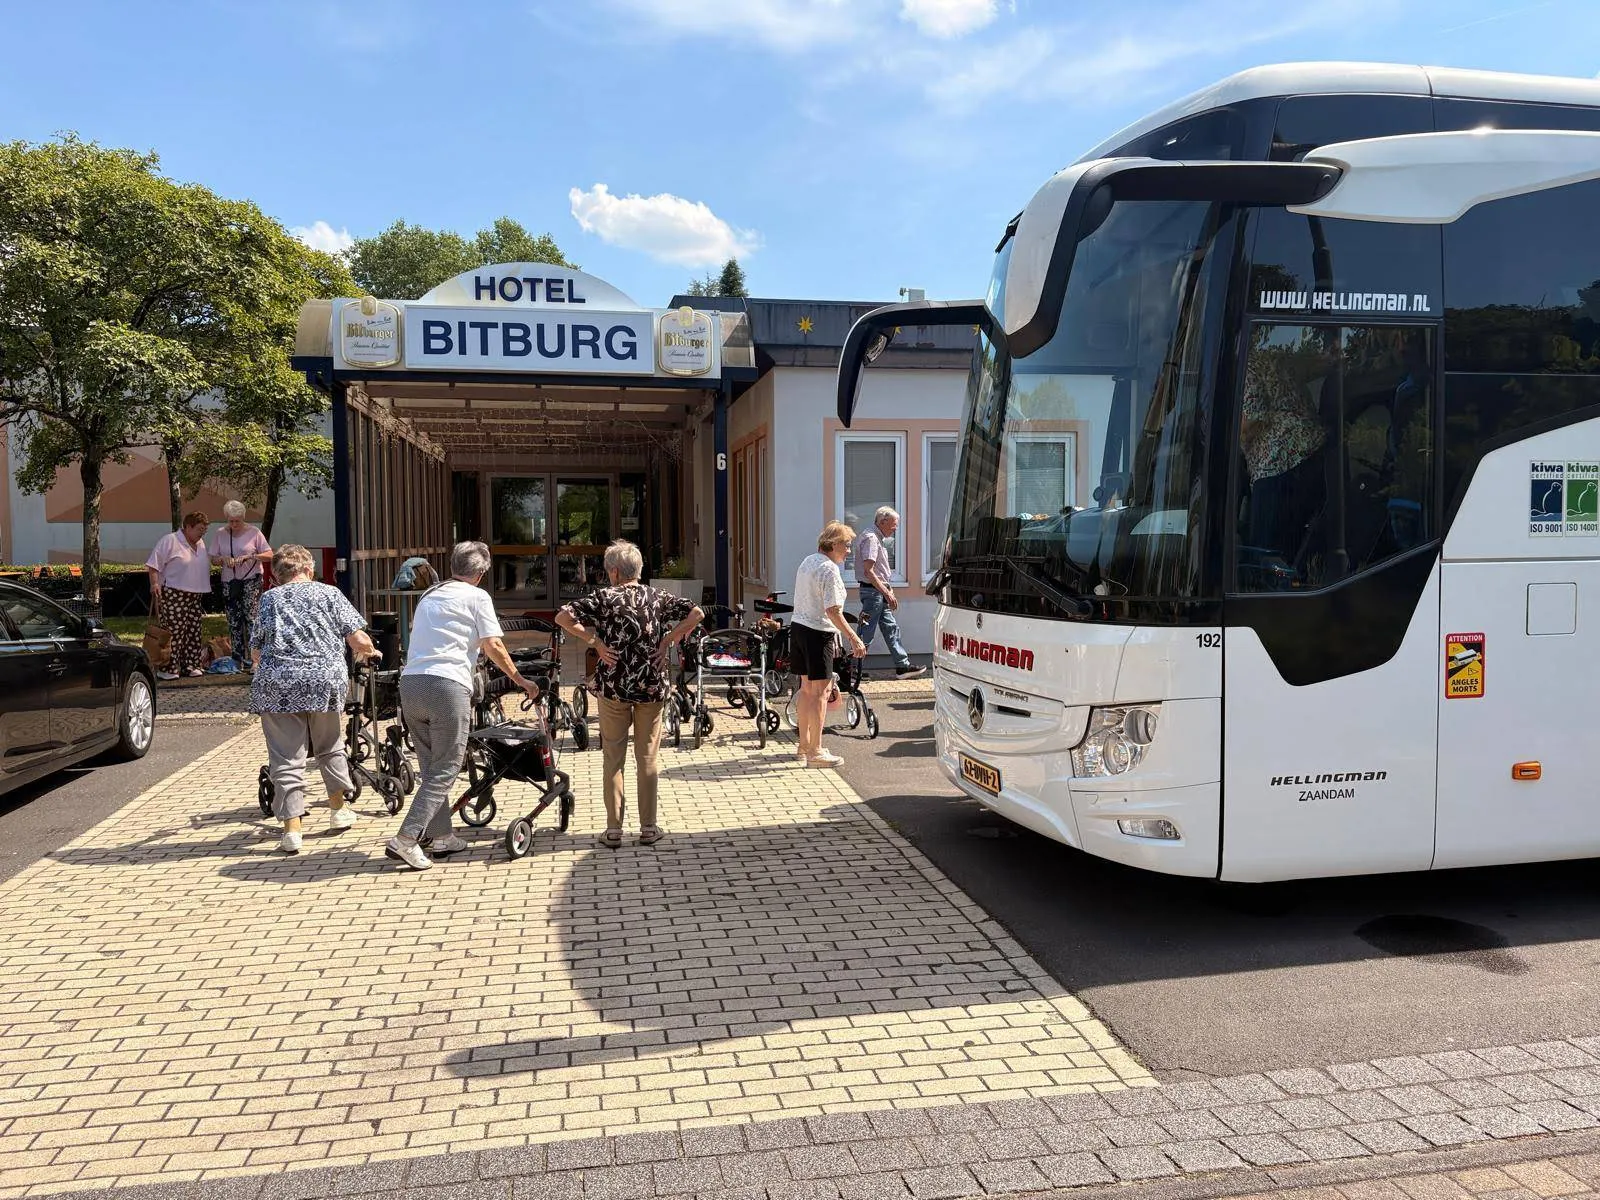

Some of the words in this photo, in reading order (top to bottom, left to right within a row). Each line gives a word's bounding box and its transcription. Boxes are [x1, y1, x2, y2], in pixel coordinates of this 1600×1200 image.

[474, 275, 586, 304] HOTEL
[422, 319, 637, 361] BITBURG
[716, 452, 726, 471] 6
[1531, 462, 1564, 473] kiwa
[1567, 463, 1599, 473] kiwa
[1530, 523, 1543, 533] ISO
[1545, 523, 1563, 533] 9001
[1566, 523, 1579, 532] ISO
[1580, 523, 1598, 532] 14001
[1195, 633, 1221, 648] 192
[1448, 634, 1483, 642] ATTENTION
[1451, 678, 1479, 686] ANGLES
[1298, 788, 1355, 802] ZAANDAM
